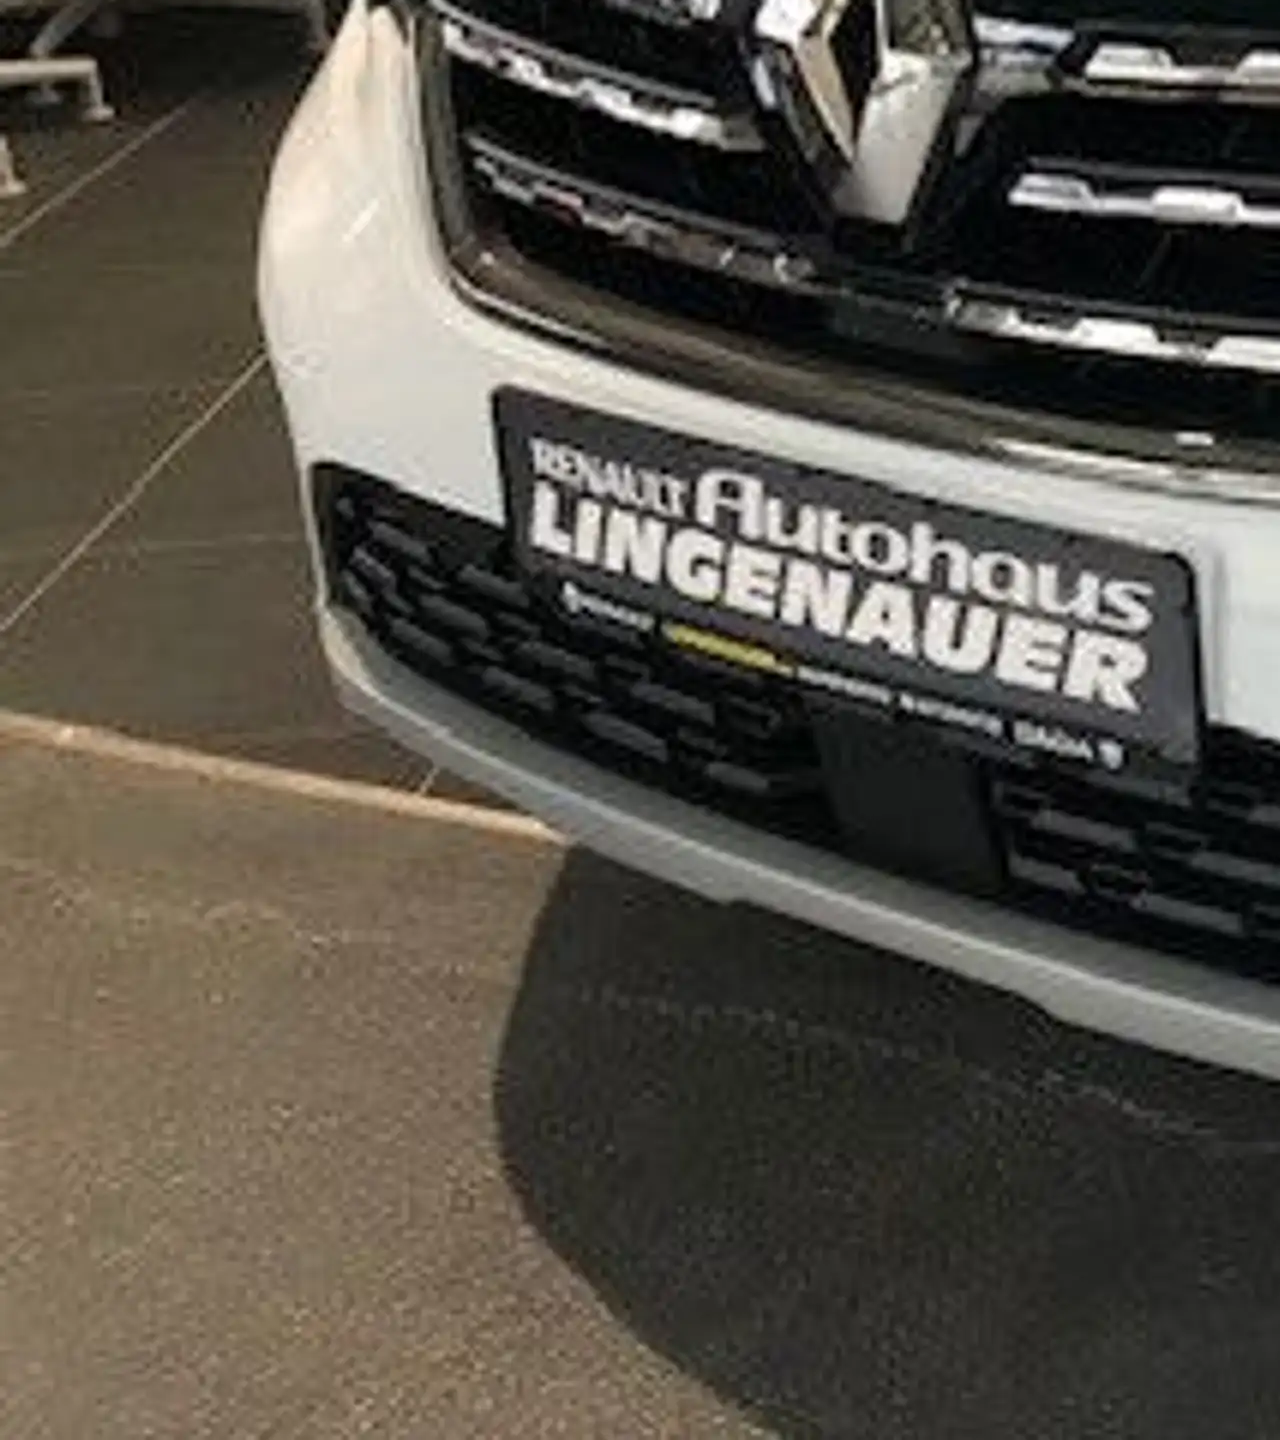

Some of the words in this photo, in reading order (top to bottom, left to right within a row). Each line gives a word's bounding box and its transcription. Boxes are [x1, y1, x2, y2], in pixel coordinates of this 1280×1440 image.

[529, 436, 689, 518] RENAULT
[695, 467, 1155, 633] Autohaus
[530, 480, 1149, 713] LINGENAUER
